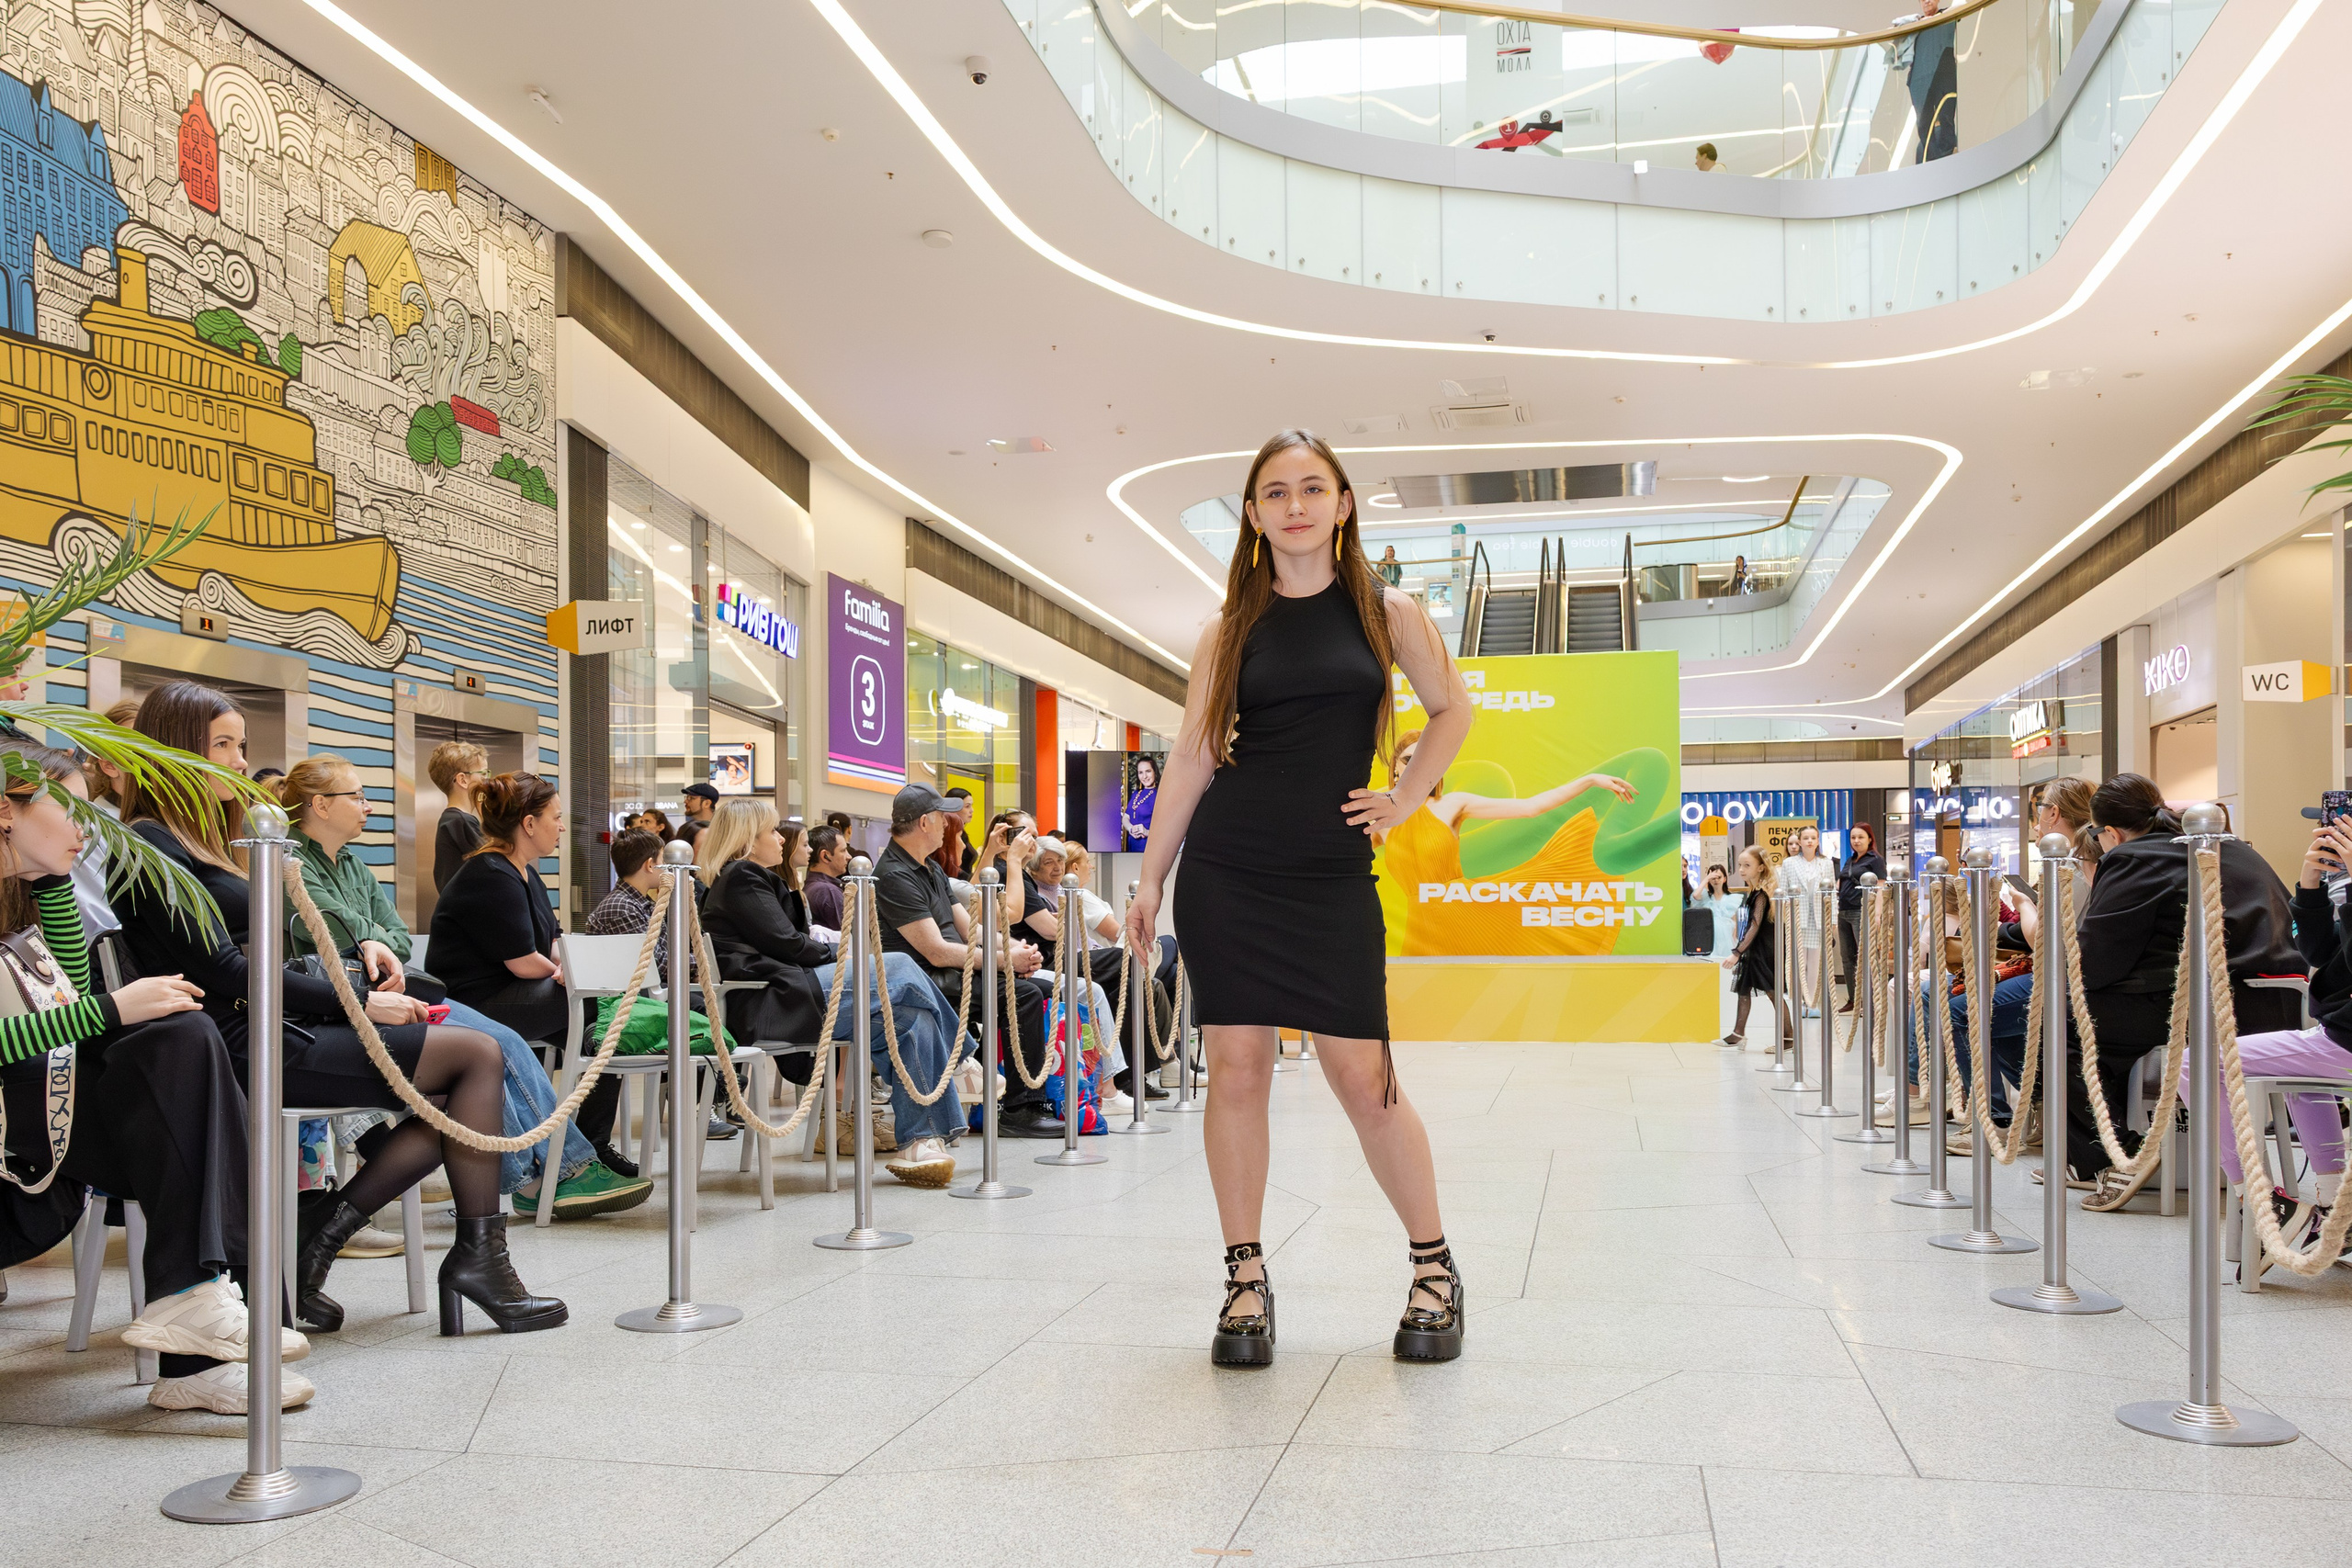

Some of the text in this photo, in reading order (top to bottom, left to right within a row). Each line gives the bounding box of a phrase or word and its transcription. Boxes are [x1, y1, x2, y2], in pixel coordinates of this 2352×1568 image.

[1497, 21, 1532, 46] ОХТА
[844, 589, 890, 633] familia
[585, 617, 634, 635] ЛИФТ
[738, 592, 798, 659] РИВ ГОШ
[2143, 644, 2191, 696] KIKO
[2251, 672, 2290, 692] WC
[861, 671, 876, 717] 3
[1393, 691, 1555, 712] ОРЕДЬ
[2009, 699, 2047, 742] ОПТИКА
[1768, 827, 1800, 835] ПЕЧАТ
[1419, 881, 1664, 904] РАСКАЧАТЬ
[1521, 906, 1665, 928] ВЕСНУ
